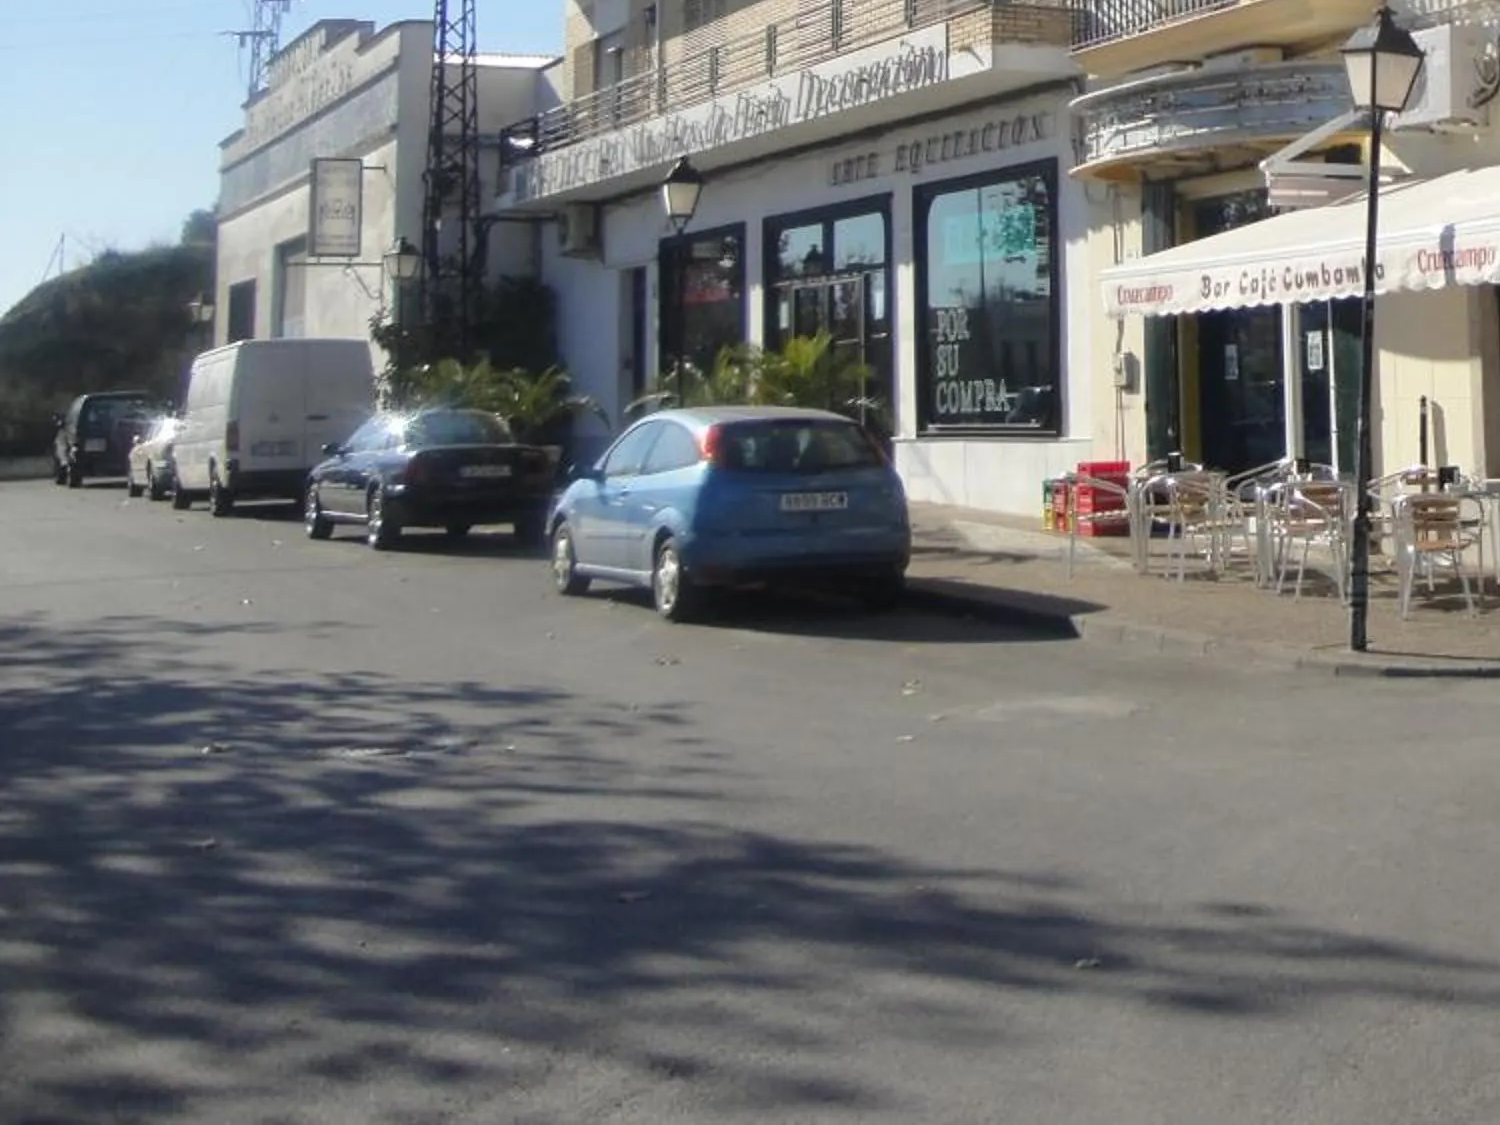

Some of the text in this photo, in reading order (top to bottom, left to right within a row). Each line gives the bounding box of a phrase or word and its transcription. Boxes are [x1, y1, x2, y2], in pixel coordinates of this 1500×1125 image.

[1201, 274, 1230, 299] Bar
[1283, 257, 1385, 293] Cumbama
[936, 308, 970, 342] POR
[936, 344, 960, 377] SU
[935, 378, 1011, 414] COMPRA
